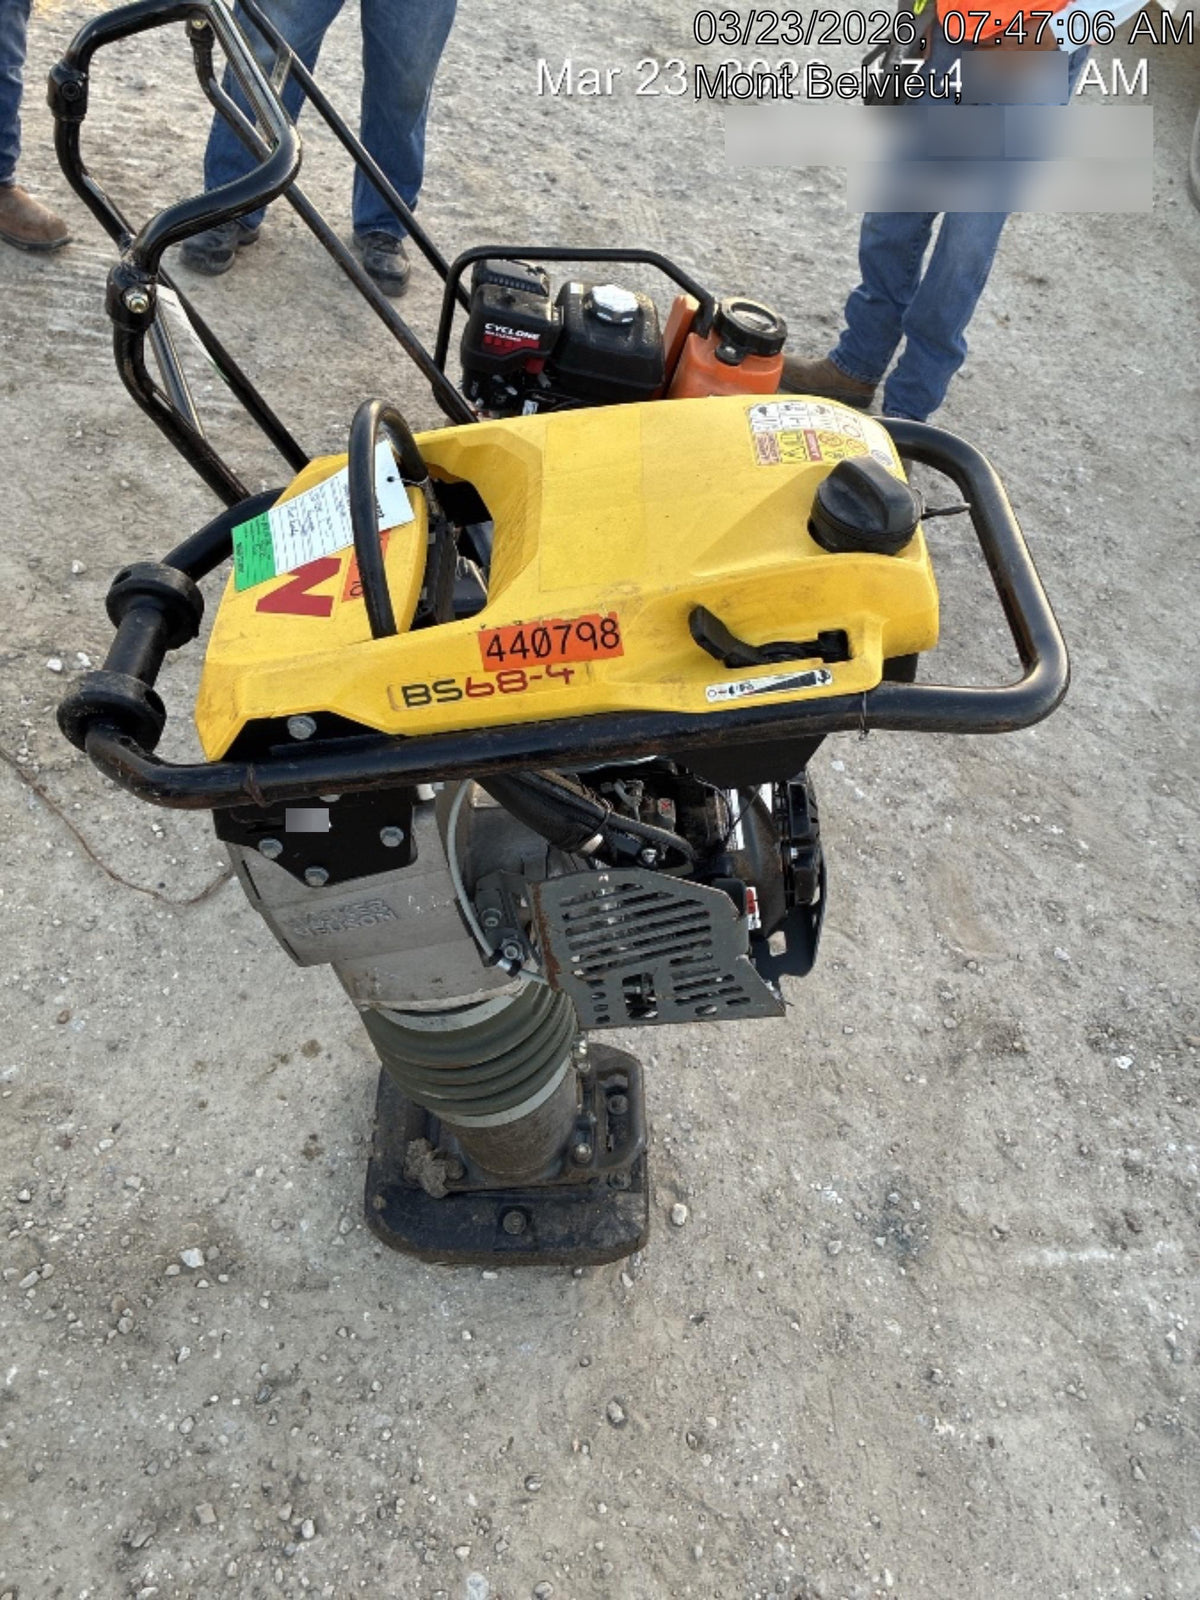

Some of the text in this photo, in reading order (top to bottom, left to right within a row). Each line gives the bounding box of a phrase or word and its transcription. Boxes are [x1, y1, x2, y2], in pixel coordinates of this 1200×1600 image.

[485, 323, 541, 341] CYCLONE
[486, 617, 620, 662] 440798
[401, 664, 575, 708] BS68-4
